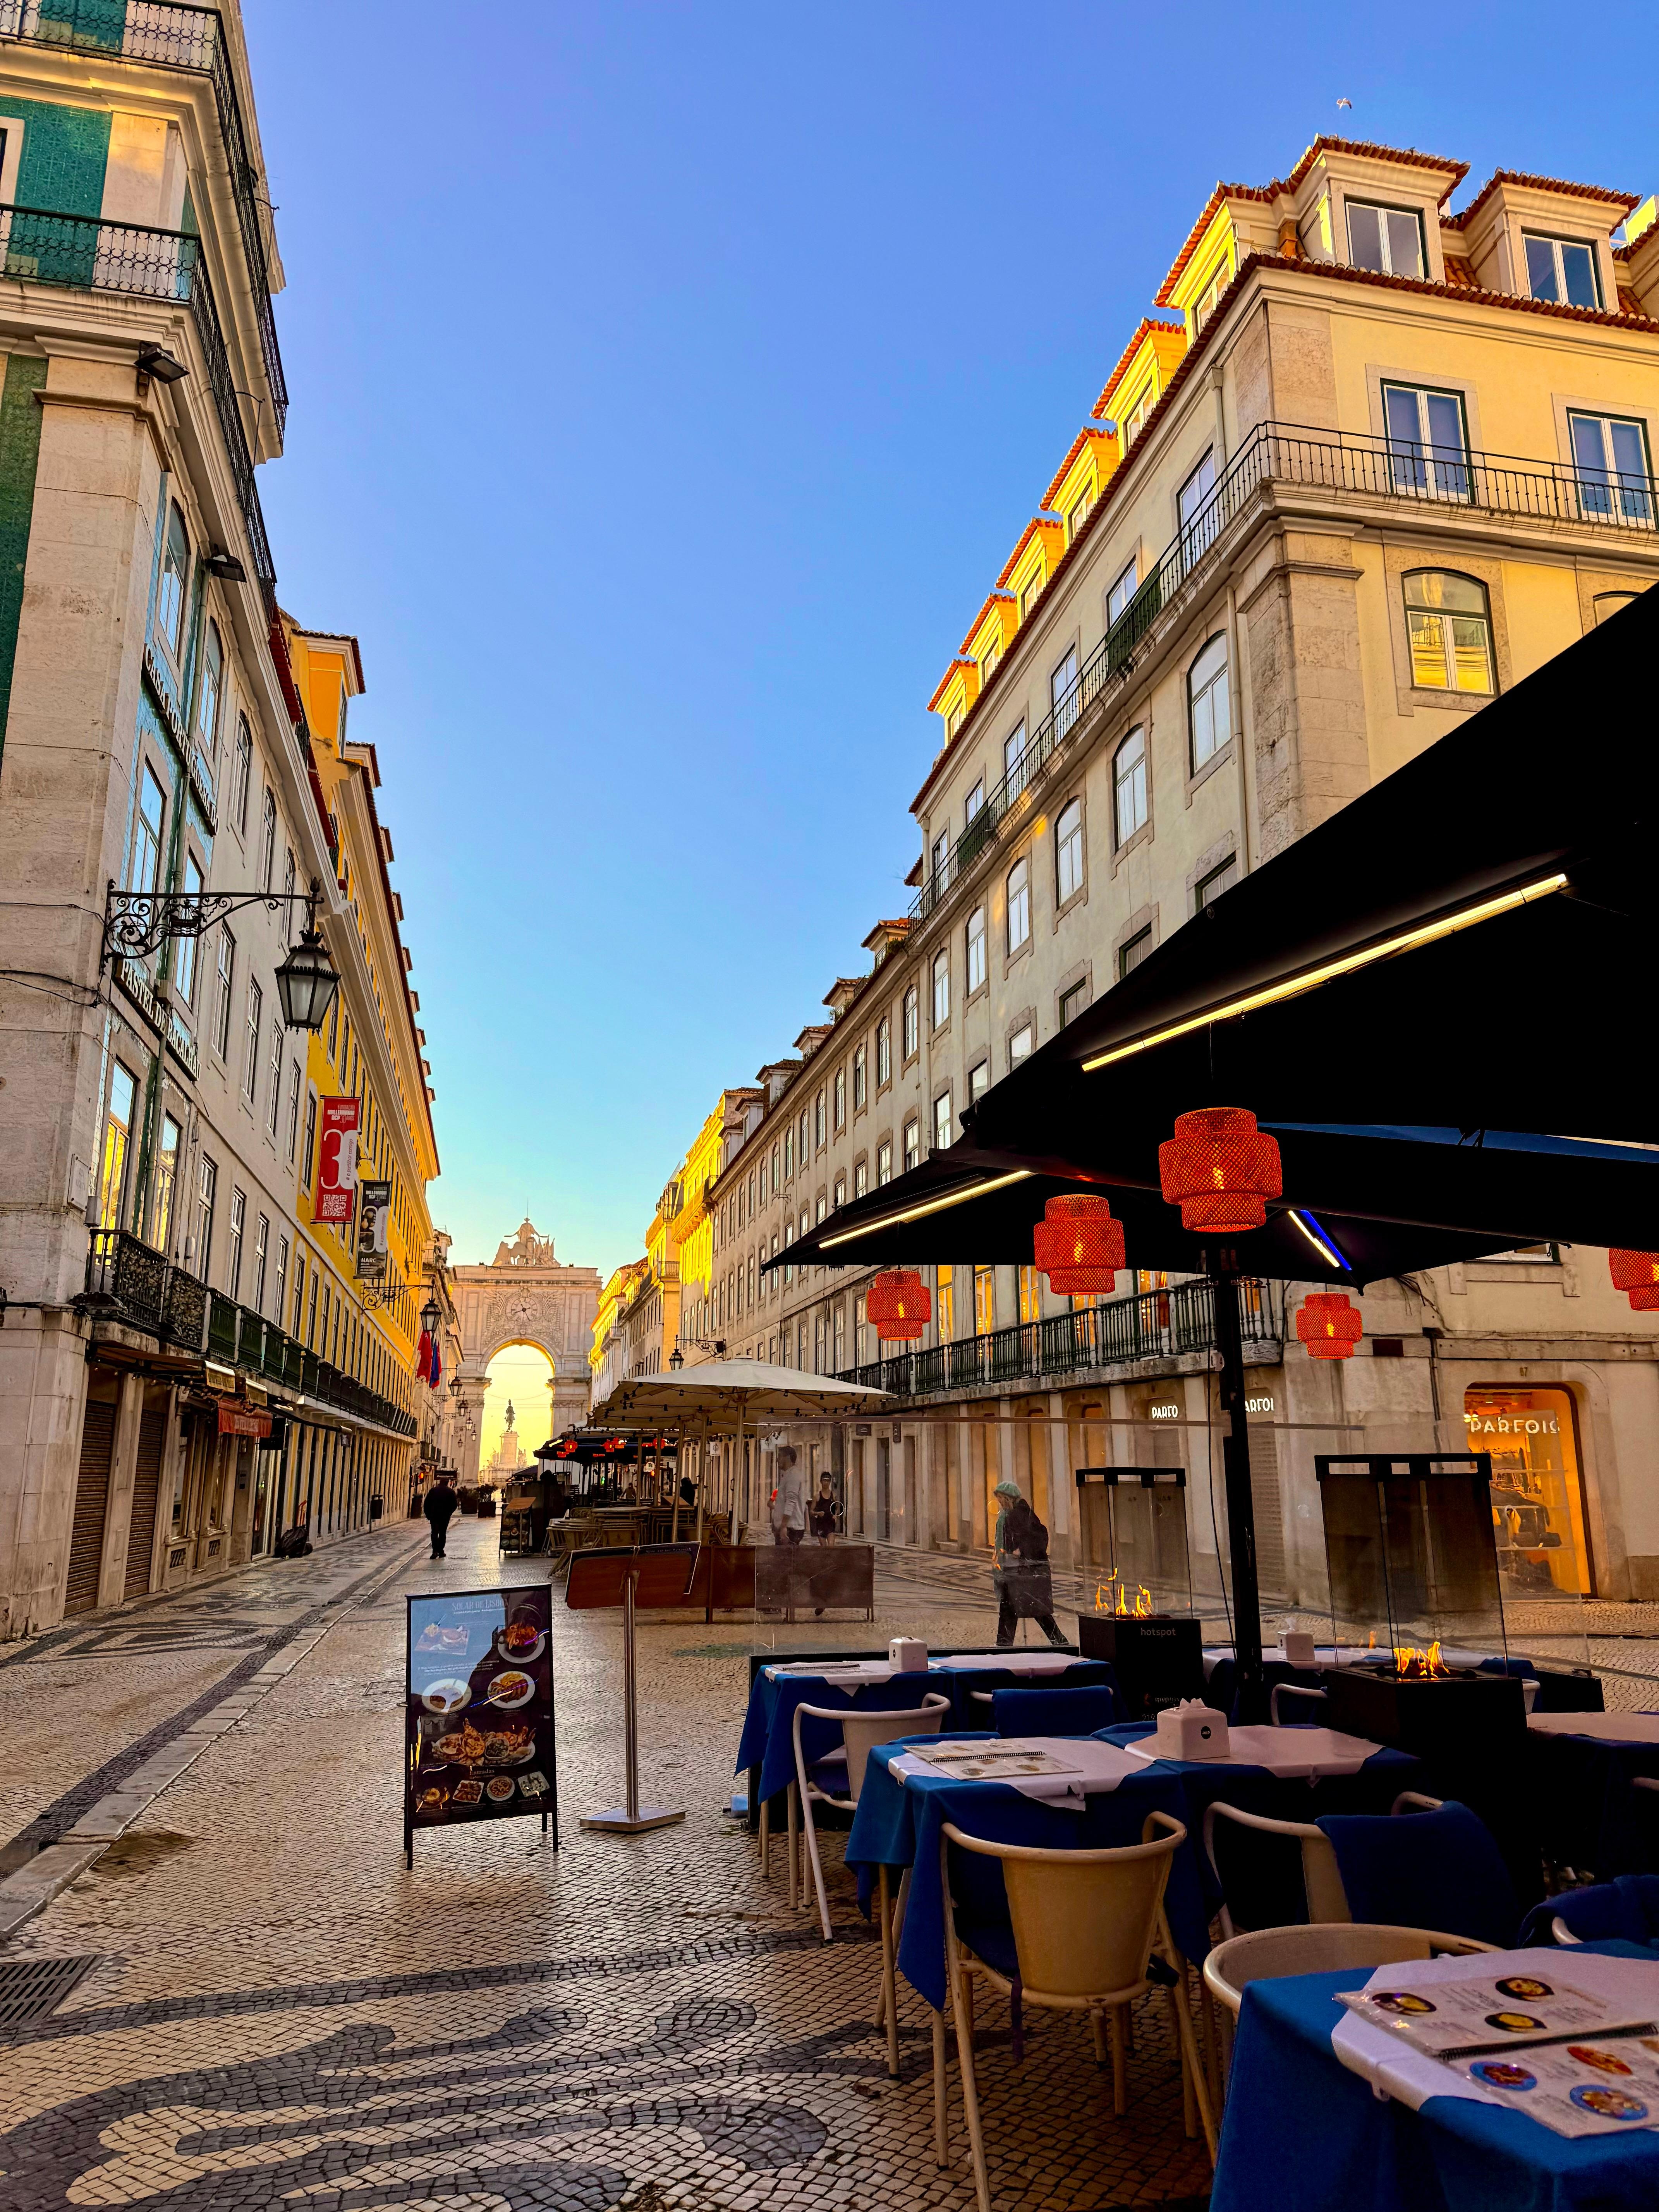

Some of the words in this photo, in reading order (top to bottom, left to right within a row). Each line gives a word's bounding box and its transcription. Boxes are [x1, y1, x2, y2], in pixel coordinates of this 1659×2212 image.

[145, 643, 166, 709] CASA
[166, 700, 210, 817] PORTUGUESA
[210, 804, 220, 836] DO
[120, 959, 154, 1020] PASTEL
[155, 1001, 168, 1034] DE
[167, 1015, 202, 1081] BACALHAU
[1245, 1398, 1274, 1413] ARFOI
[1471, 1419, 1559, 1434] PARFOIS
[452, 1601, 473, 1611] SOLAR
[1141, 1627, 1176, 1638] hotspot
